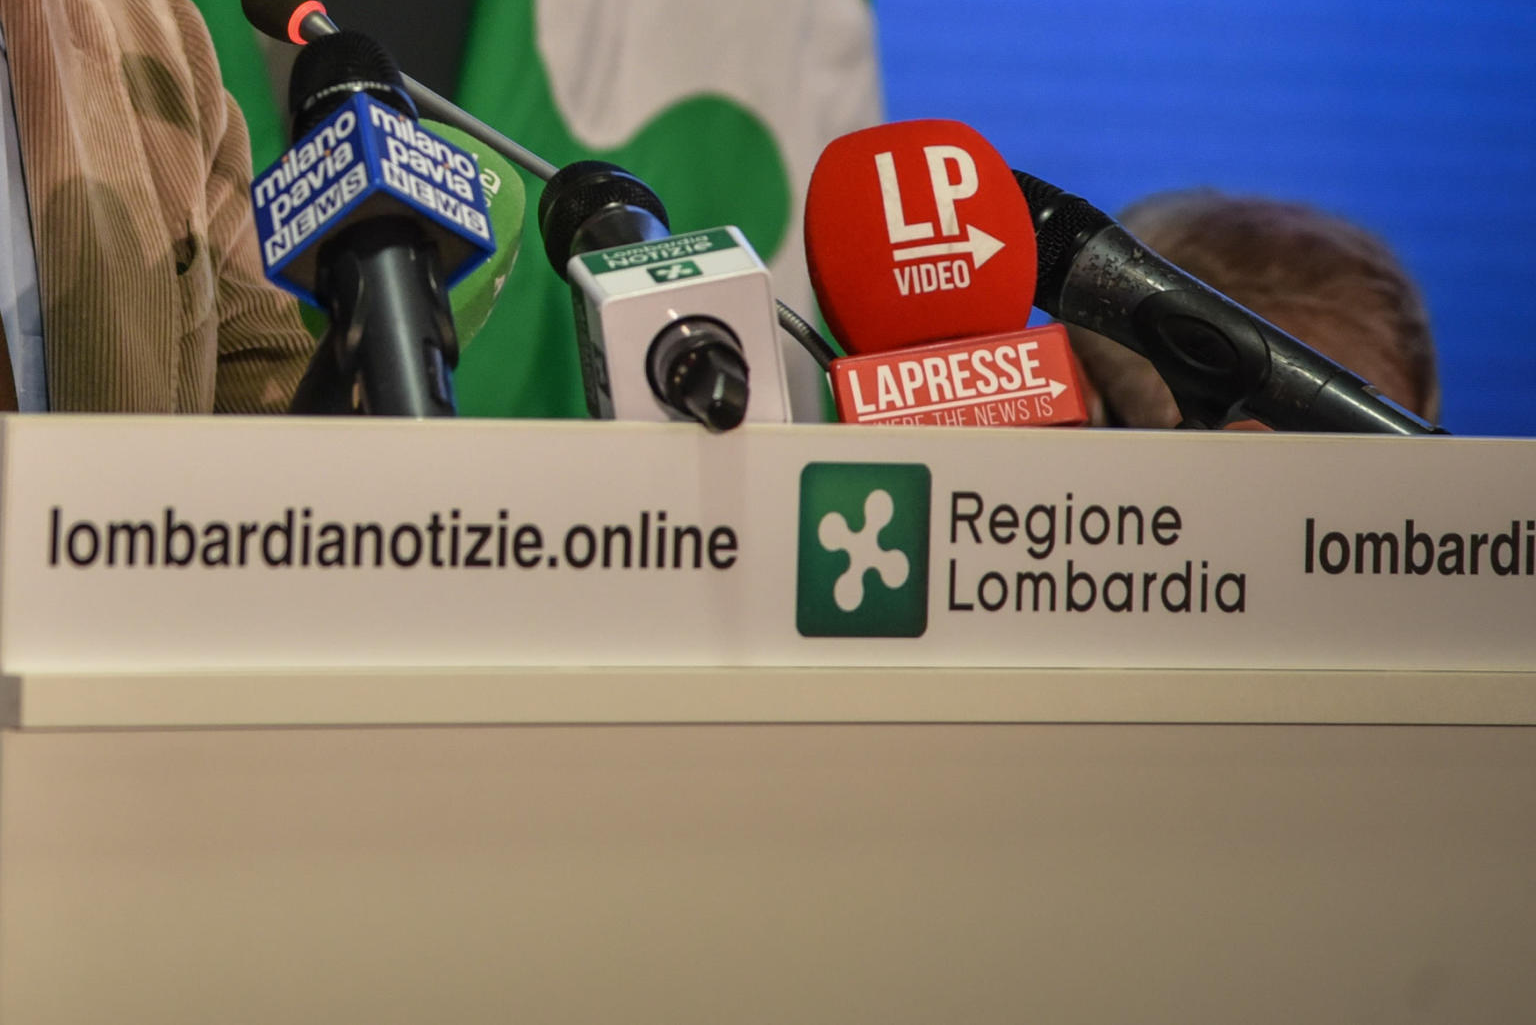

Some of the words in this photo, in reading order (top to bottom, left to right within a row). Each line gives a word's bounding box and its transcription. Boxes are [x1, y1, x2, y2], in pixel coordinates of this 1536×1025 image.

[254, 111, 356, 208] milano
[369, 104, 475, 179] milano
[386, 136, 474, 202] pavia
[266, 163, 367, 265] NEWS
[270, 142, 354, 231] pavia
[382, 160, 490, 239] NEWS
[874, 145, 979, 244] LP
[602, 235, 709, 261] Lombardia
[893, 259, 971, 296] VIDEO
[848, 342, 1047, 414] LAPRESSE
[974, 399, 1030, 425] NEWS
[1034, 395, 1054, 418] IS
[48, 507, 739, 570] lombardianotizie.online
[949, 491, 1182, 559] Regione
[948, 558, 1247, 613] Lombardia
